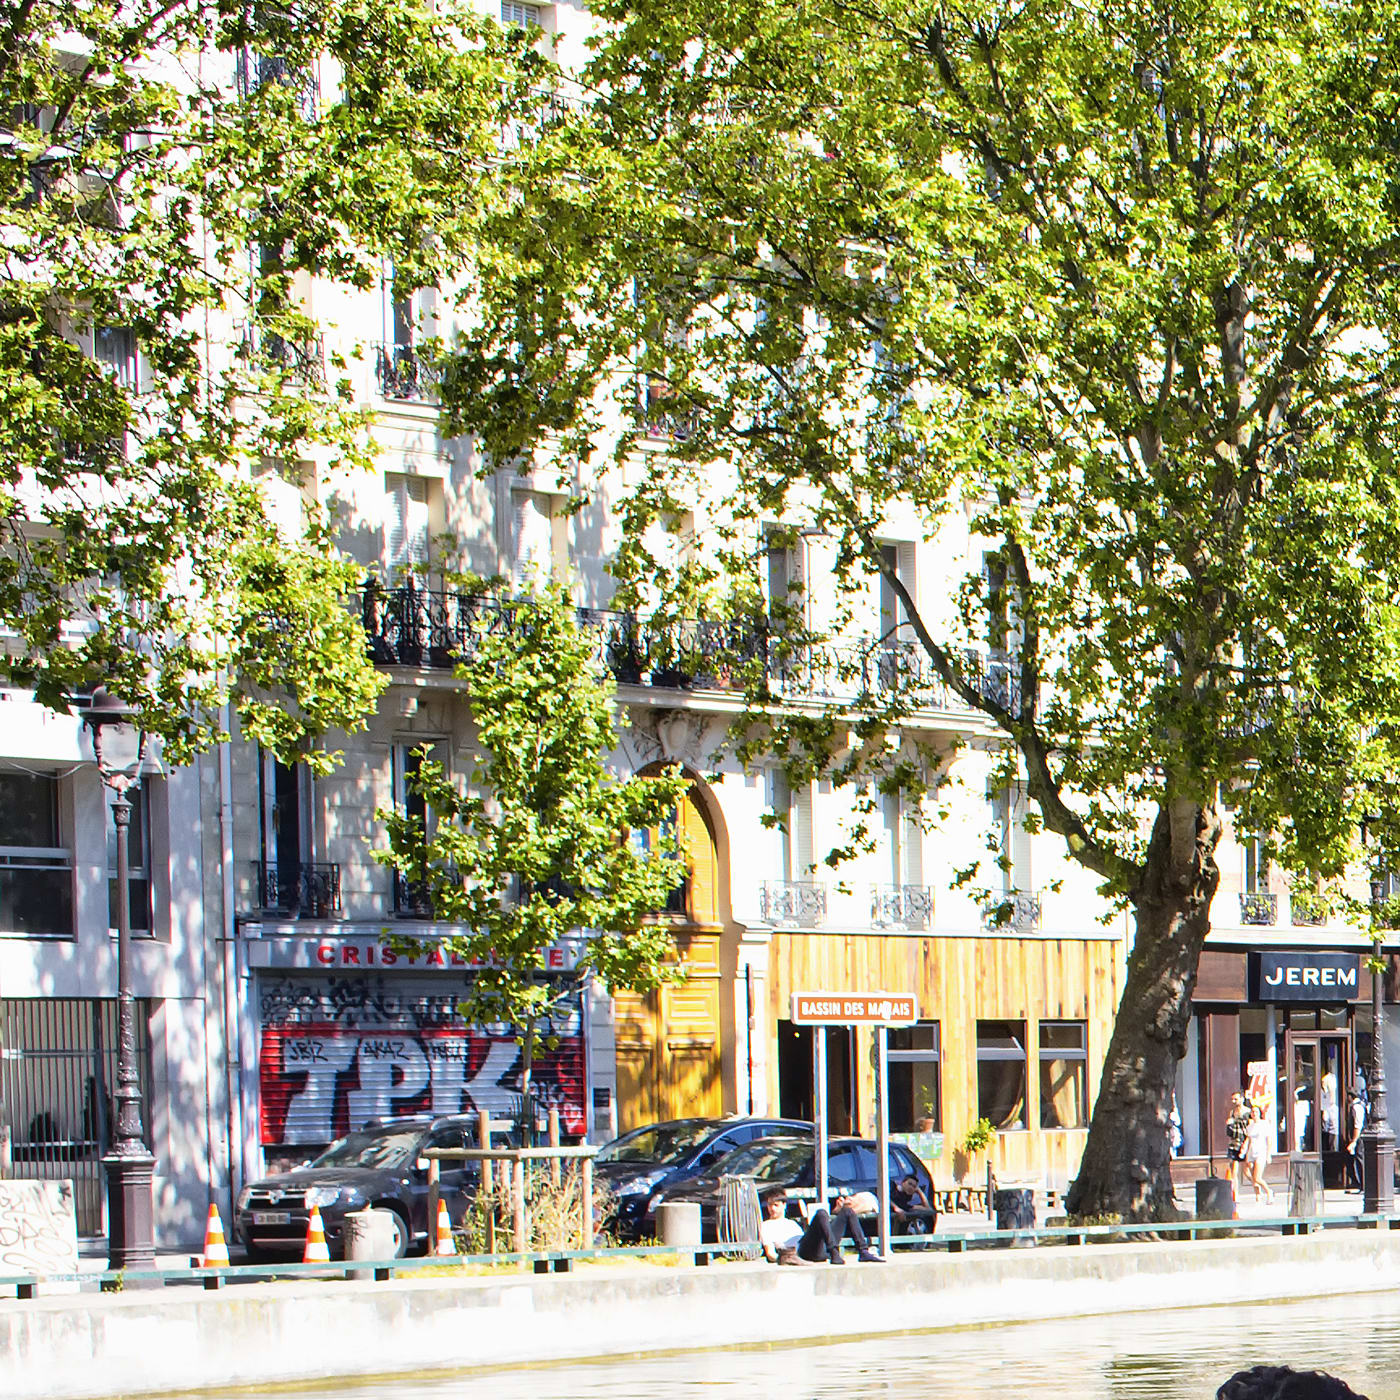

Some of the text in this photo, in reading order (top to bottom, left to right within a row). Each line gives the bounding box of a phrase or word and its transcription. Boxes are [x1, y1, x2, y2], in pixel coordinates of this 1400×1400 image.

[317, 947, 563, 966] CRISALLE
[1265, 967, 1356, 986] JEREM
[801, 1002, 840, 1015] BASSIN
[843, 1002, 864, 1015] DES
